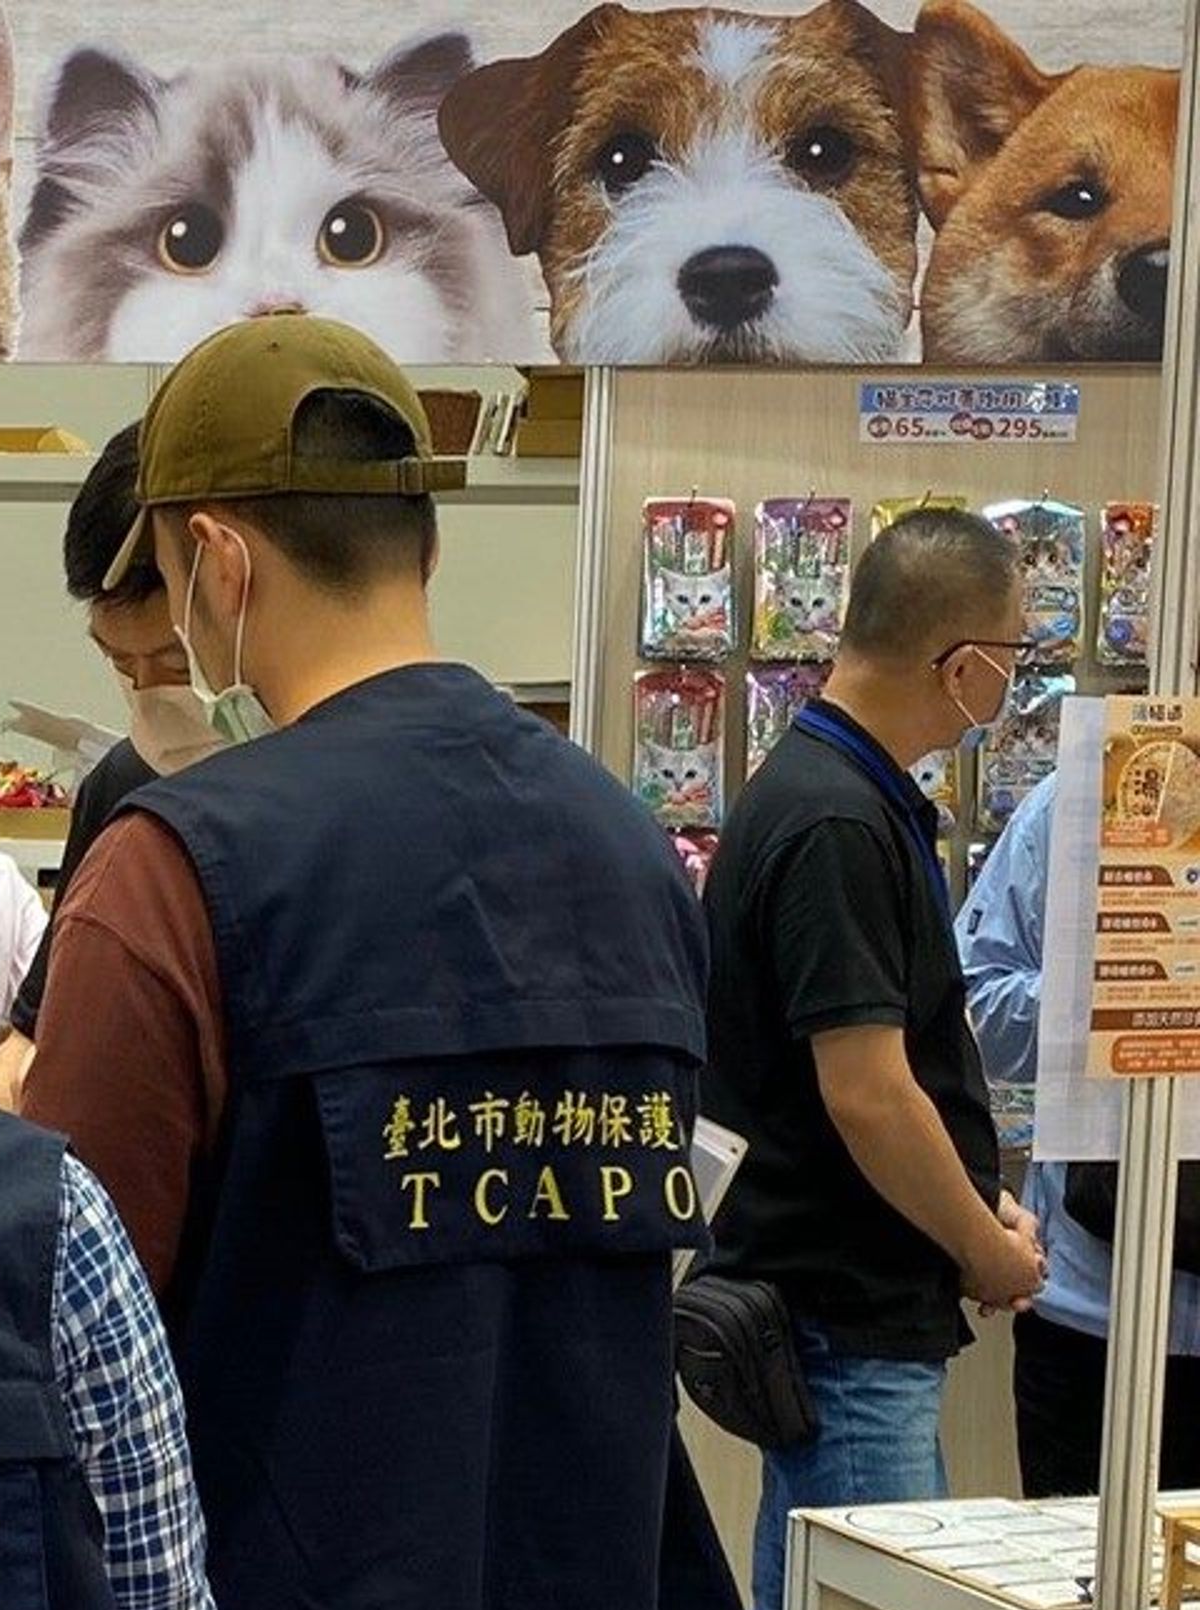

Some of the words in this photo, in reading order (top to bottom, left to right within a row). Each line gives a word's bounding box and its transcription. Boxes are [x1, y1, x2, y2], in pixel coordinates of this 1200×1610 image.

[895, 416, 924, 438] 65
[999, 417, 1042, 438] 295
[381, 1090, 688, 1160] 臺北市動物保護
